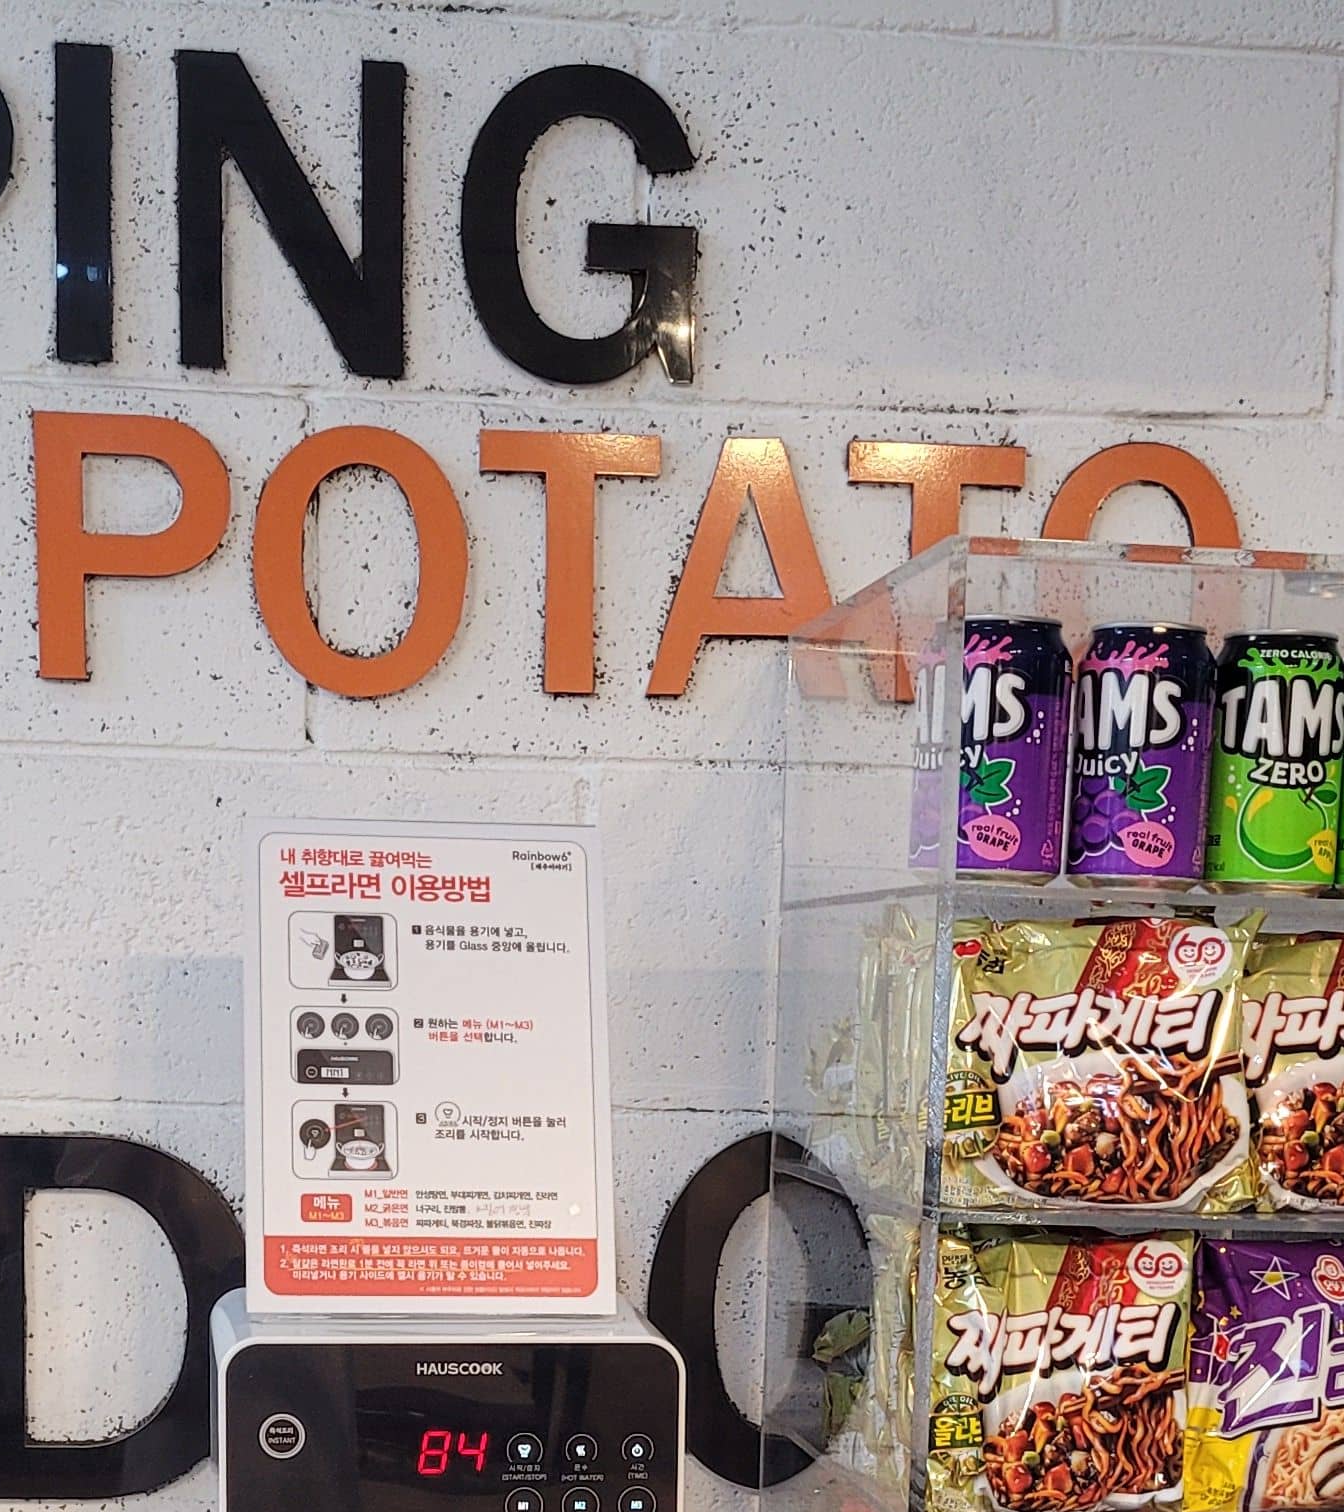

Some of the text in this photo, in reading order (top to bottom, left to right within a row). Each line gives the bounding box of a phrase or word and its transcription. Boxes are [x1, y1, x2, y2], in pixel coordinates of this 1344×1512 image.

[32, 408, 1242, 702] POTATO
[1258, 648, 1285, 660] ZERO
[1250, 759, 1325, 785] ZERO
[975, 832, 1011, 853] GRAPE
[1130, 840, 1165, 860] GRAPE
[280, 849, 432, 868] 내 취향대로 끓여먹는
[279, 871, 491, 902] 셀프라면 이용방법
[425, 925, 466, 936] 음식물을
[469, 925, 501, 937] 용기에
[425, 939, 570, 953] 용기를 Glass 중앙에 올립니다.
[428, 1018, 458, 1029] 원하는
[462, 1020, 482, 1029] 메뉴
[429, 1031, 517, 1043] 버튼을 선택합니다.
[957, 989, 1221, 1080] 짜파게티
[462, 1116, 566, 1127] 시작/정지 버튼을 눌러
[435, 1129, 524, 1141] 조리를 시작합니다.
[313, 1196, 341, 1209] 메뉴
[416, 1362, 503, 1377] HAUSCOOK
[267, 1436, 296, 1445] INSTANT
[417, 1430, 488, 1476] 84
[517, 1500, 643, 1510] M1 M2 M3
